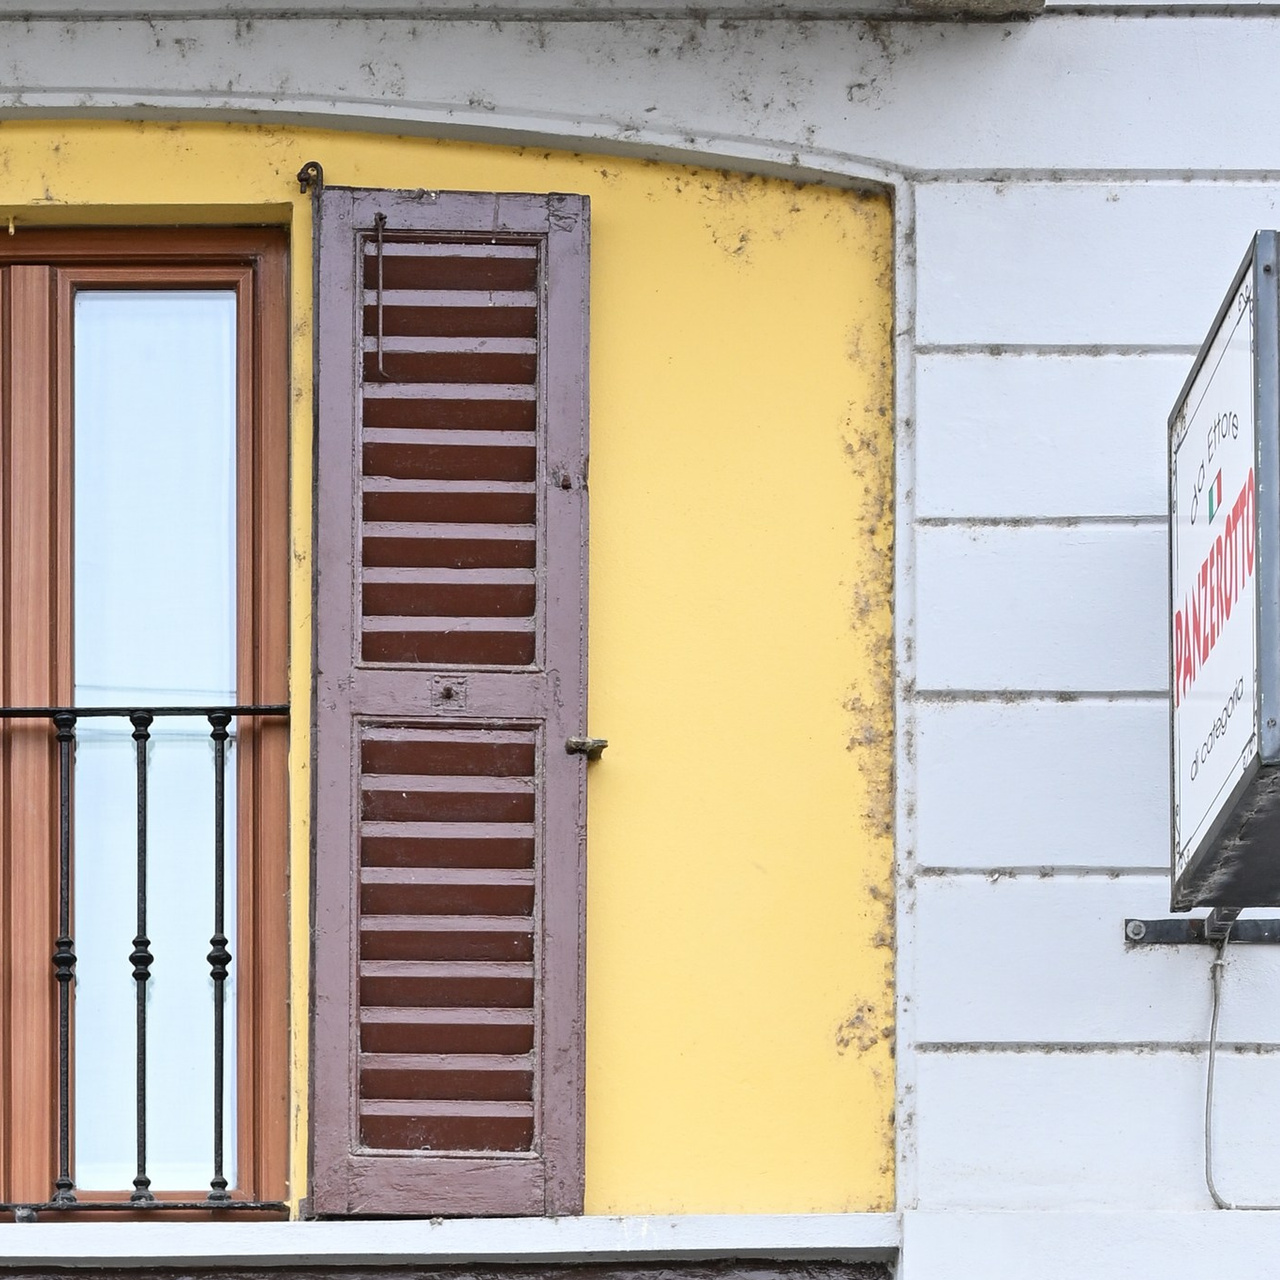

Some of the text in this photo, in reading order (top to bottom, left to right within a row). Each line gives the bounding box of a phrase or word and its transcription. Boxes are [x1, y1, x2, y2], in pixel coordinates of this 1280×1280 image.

[1191, 411, 1239, 525] da Ettore
[1175, 467, 1255, 709] PANZEROTTO
[1190, 676, 1244, 781] di categoria
